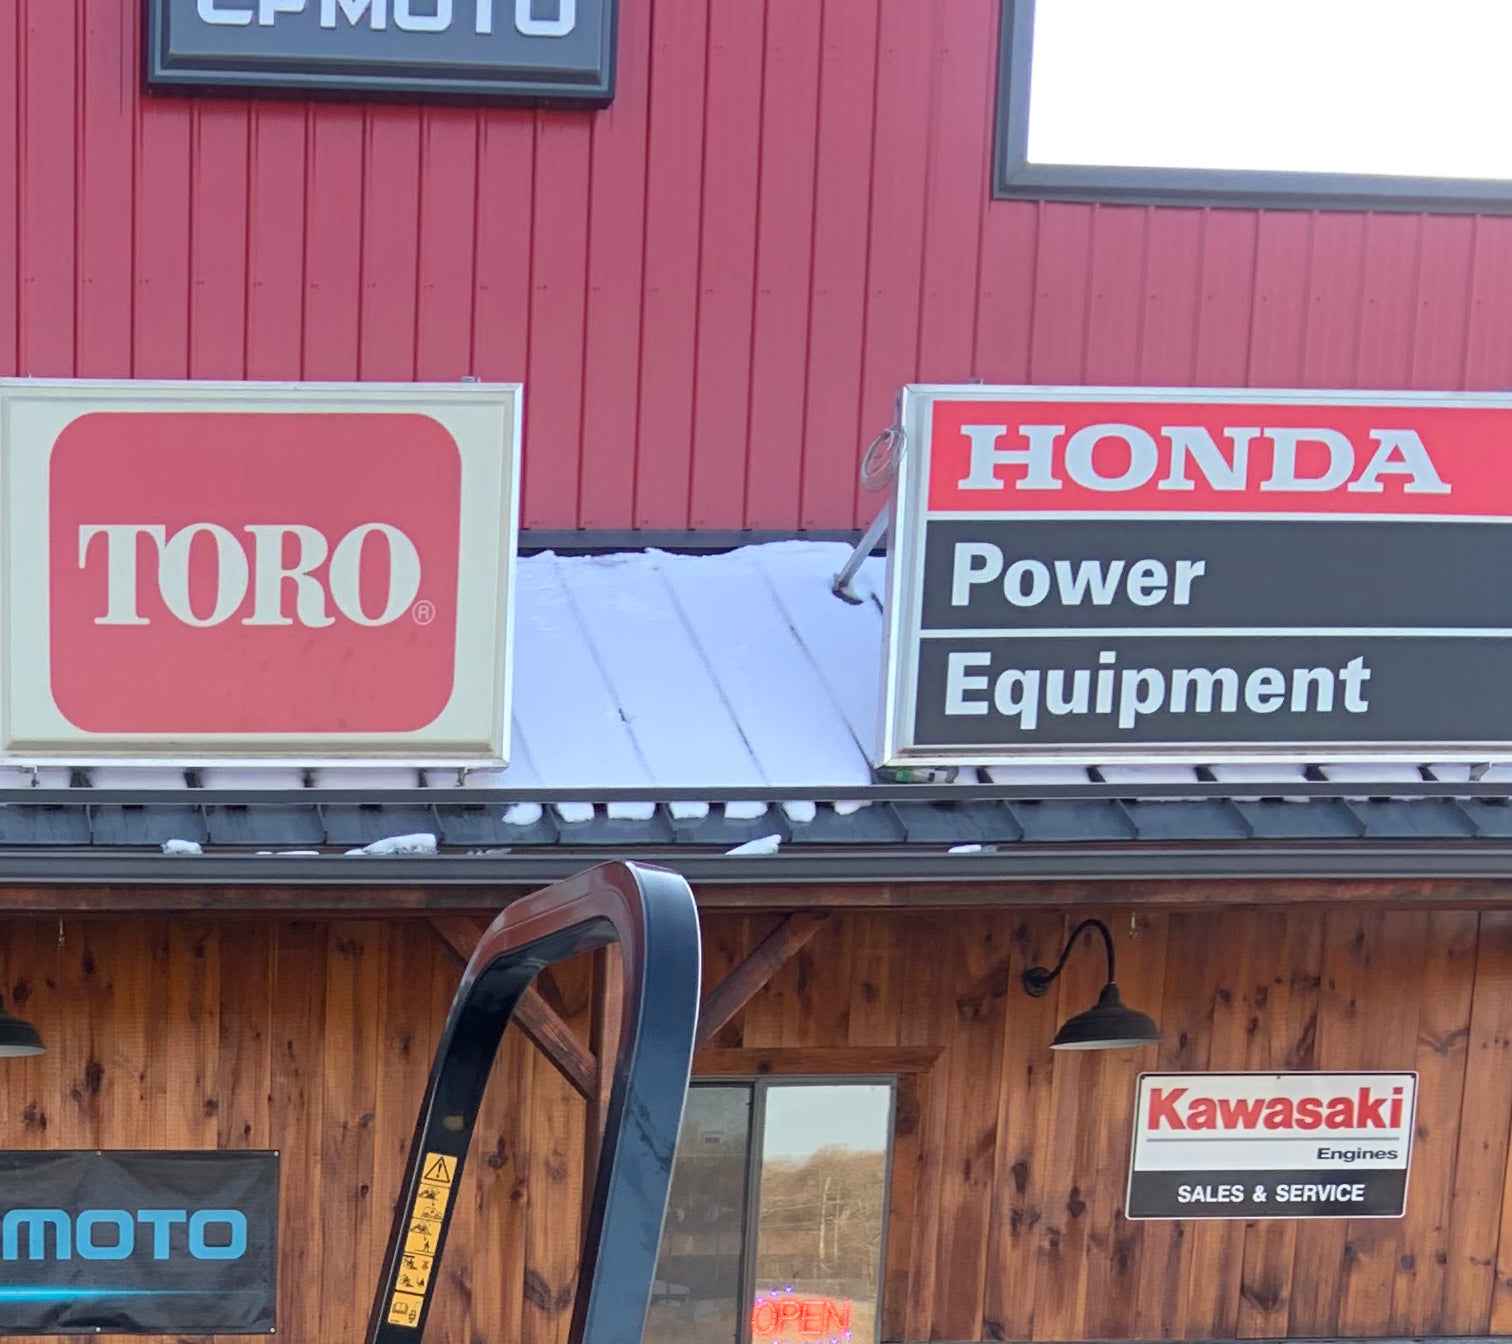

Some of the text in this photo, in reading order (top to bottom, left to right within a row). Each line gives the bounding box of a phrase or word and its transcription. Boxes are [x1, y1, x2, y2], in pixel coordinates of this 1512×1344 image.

[958, 423, 1452, 494] HONDA
[951, 542, 1206, 607] Power
[944, 651, 1371, 730] Equipment
[1147, 1087, 1403, 1130] Kawasaki
[1316, 1147, 1399, 1163] Engines
[1177, 1184, 1366, 1203] SALES & SERVICE
[752, 1299, 852, 1337] OPEN
